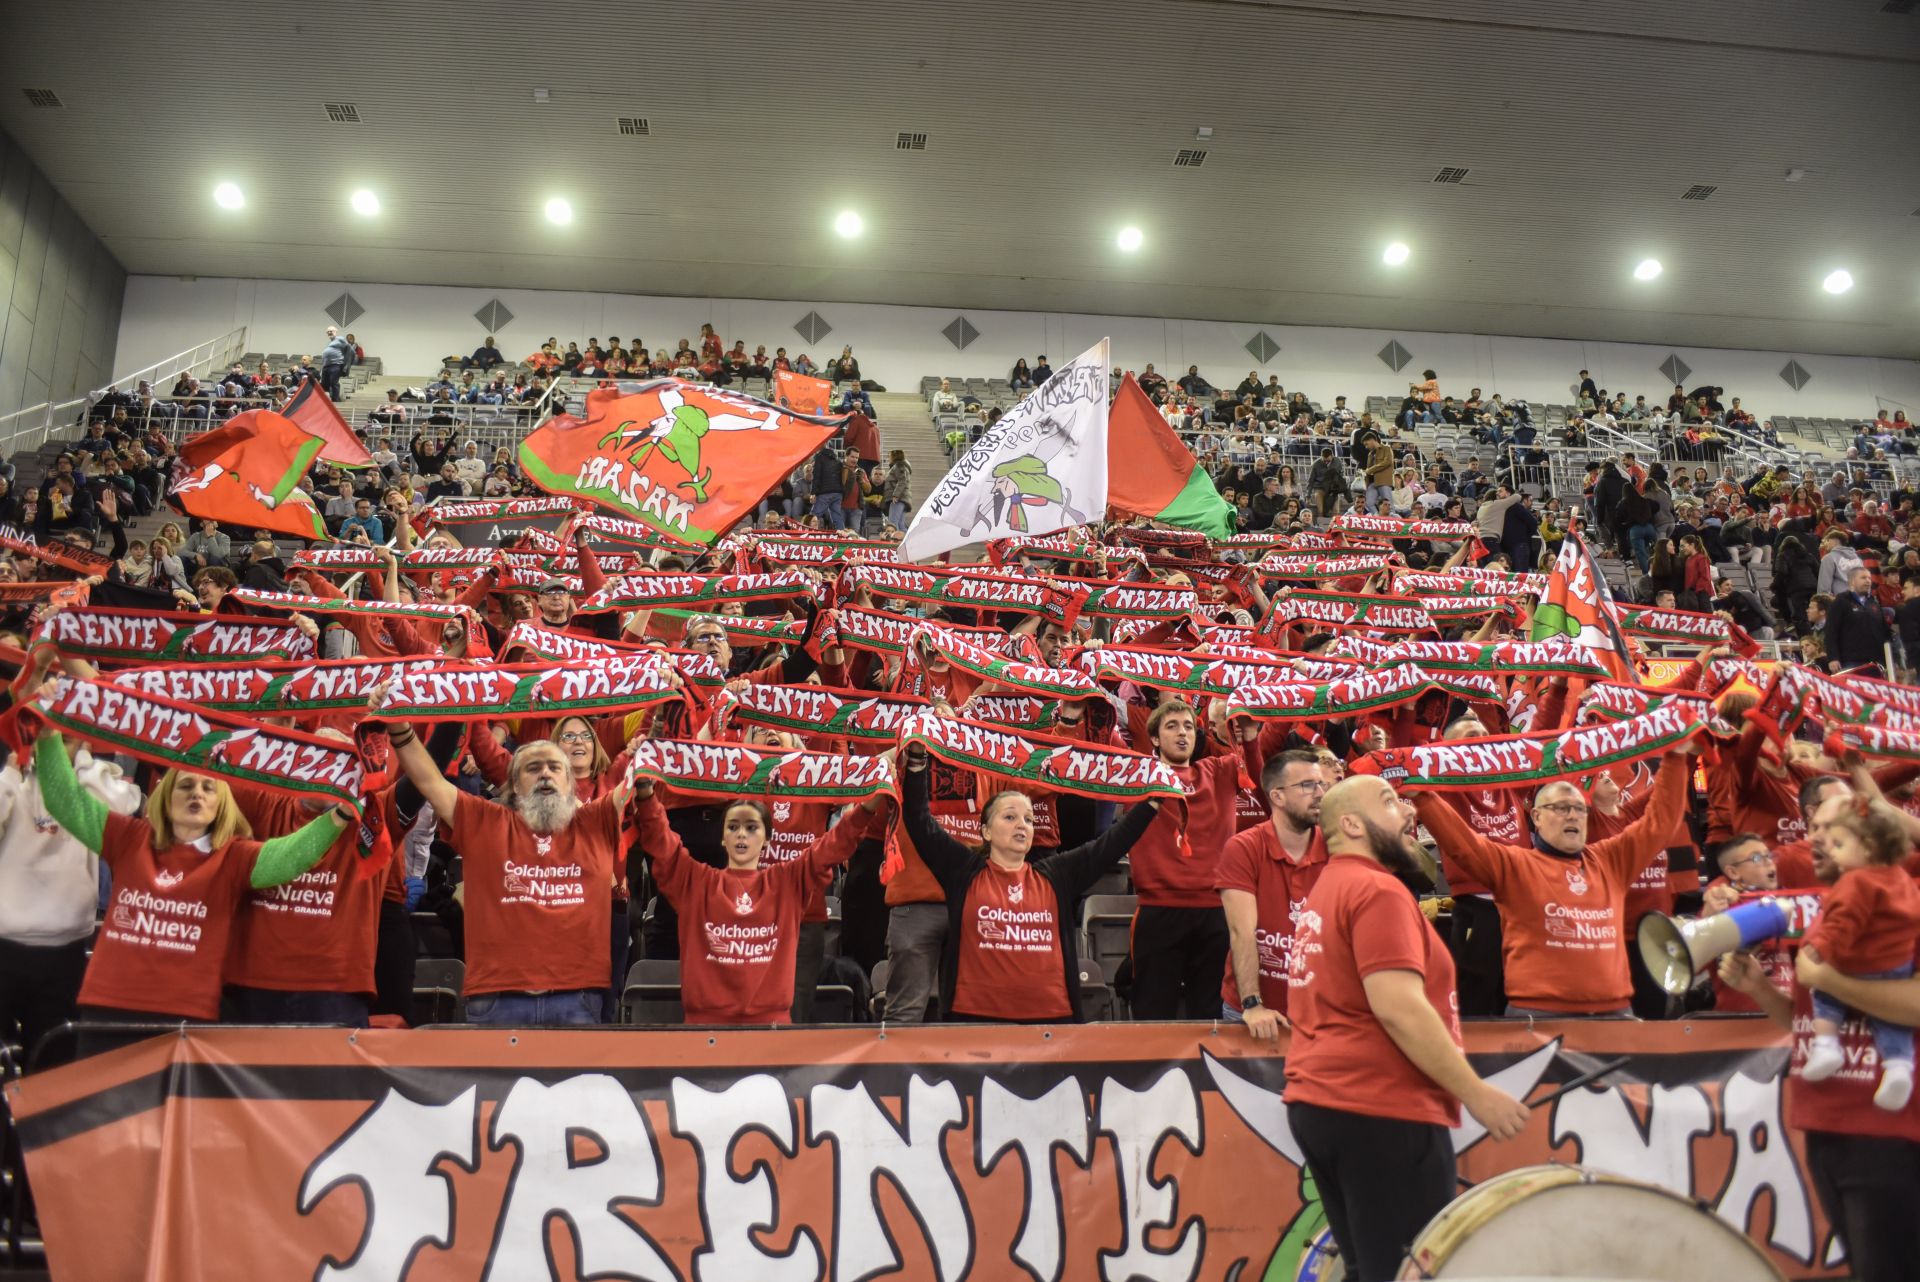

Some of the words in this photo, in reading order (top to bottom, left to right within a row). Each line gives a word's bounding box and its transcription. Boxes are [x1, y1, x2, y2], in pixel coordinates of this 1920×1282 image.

[431, 502, 494, 519] FRENTE
[1341, 515, 1397, 533] FRENTE
[1081, 650, 1180, 681] FRENTE
[41, 677, 191, 748] FRENTE
[901, 713, 1016, 765] FRENTE
[1411, 739, 1532, 780] FRENTE
[504, 860, 582, 878] Colchonería
[275, 884, 335, 906] Nueva
[530, 880, 584, 896] Nueva
[117, 887, 208, 919] Colchonería
[294, 906, 332, 917] GRANADA
[552, 897, 585, 906] GRANADA
[134, 912, 203, 941] Nueva
[1005, 924, 1053, 943] Nueva
[156, 939, 197, 952] GRANADA
[299, 1067, 1203, 1282] FRENTE
